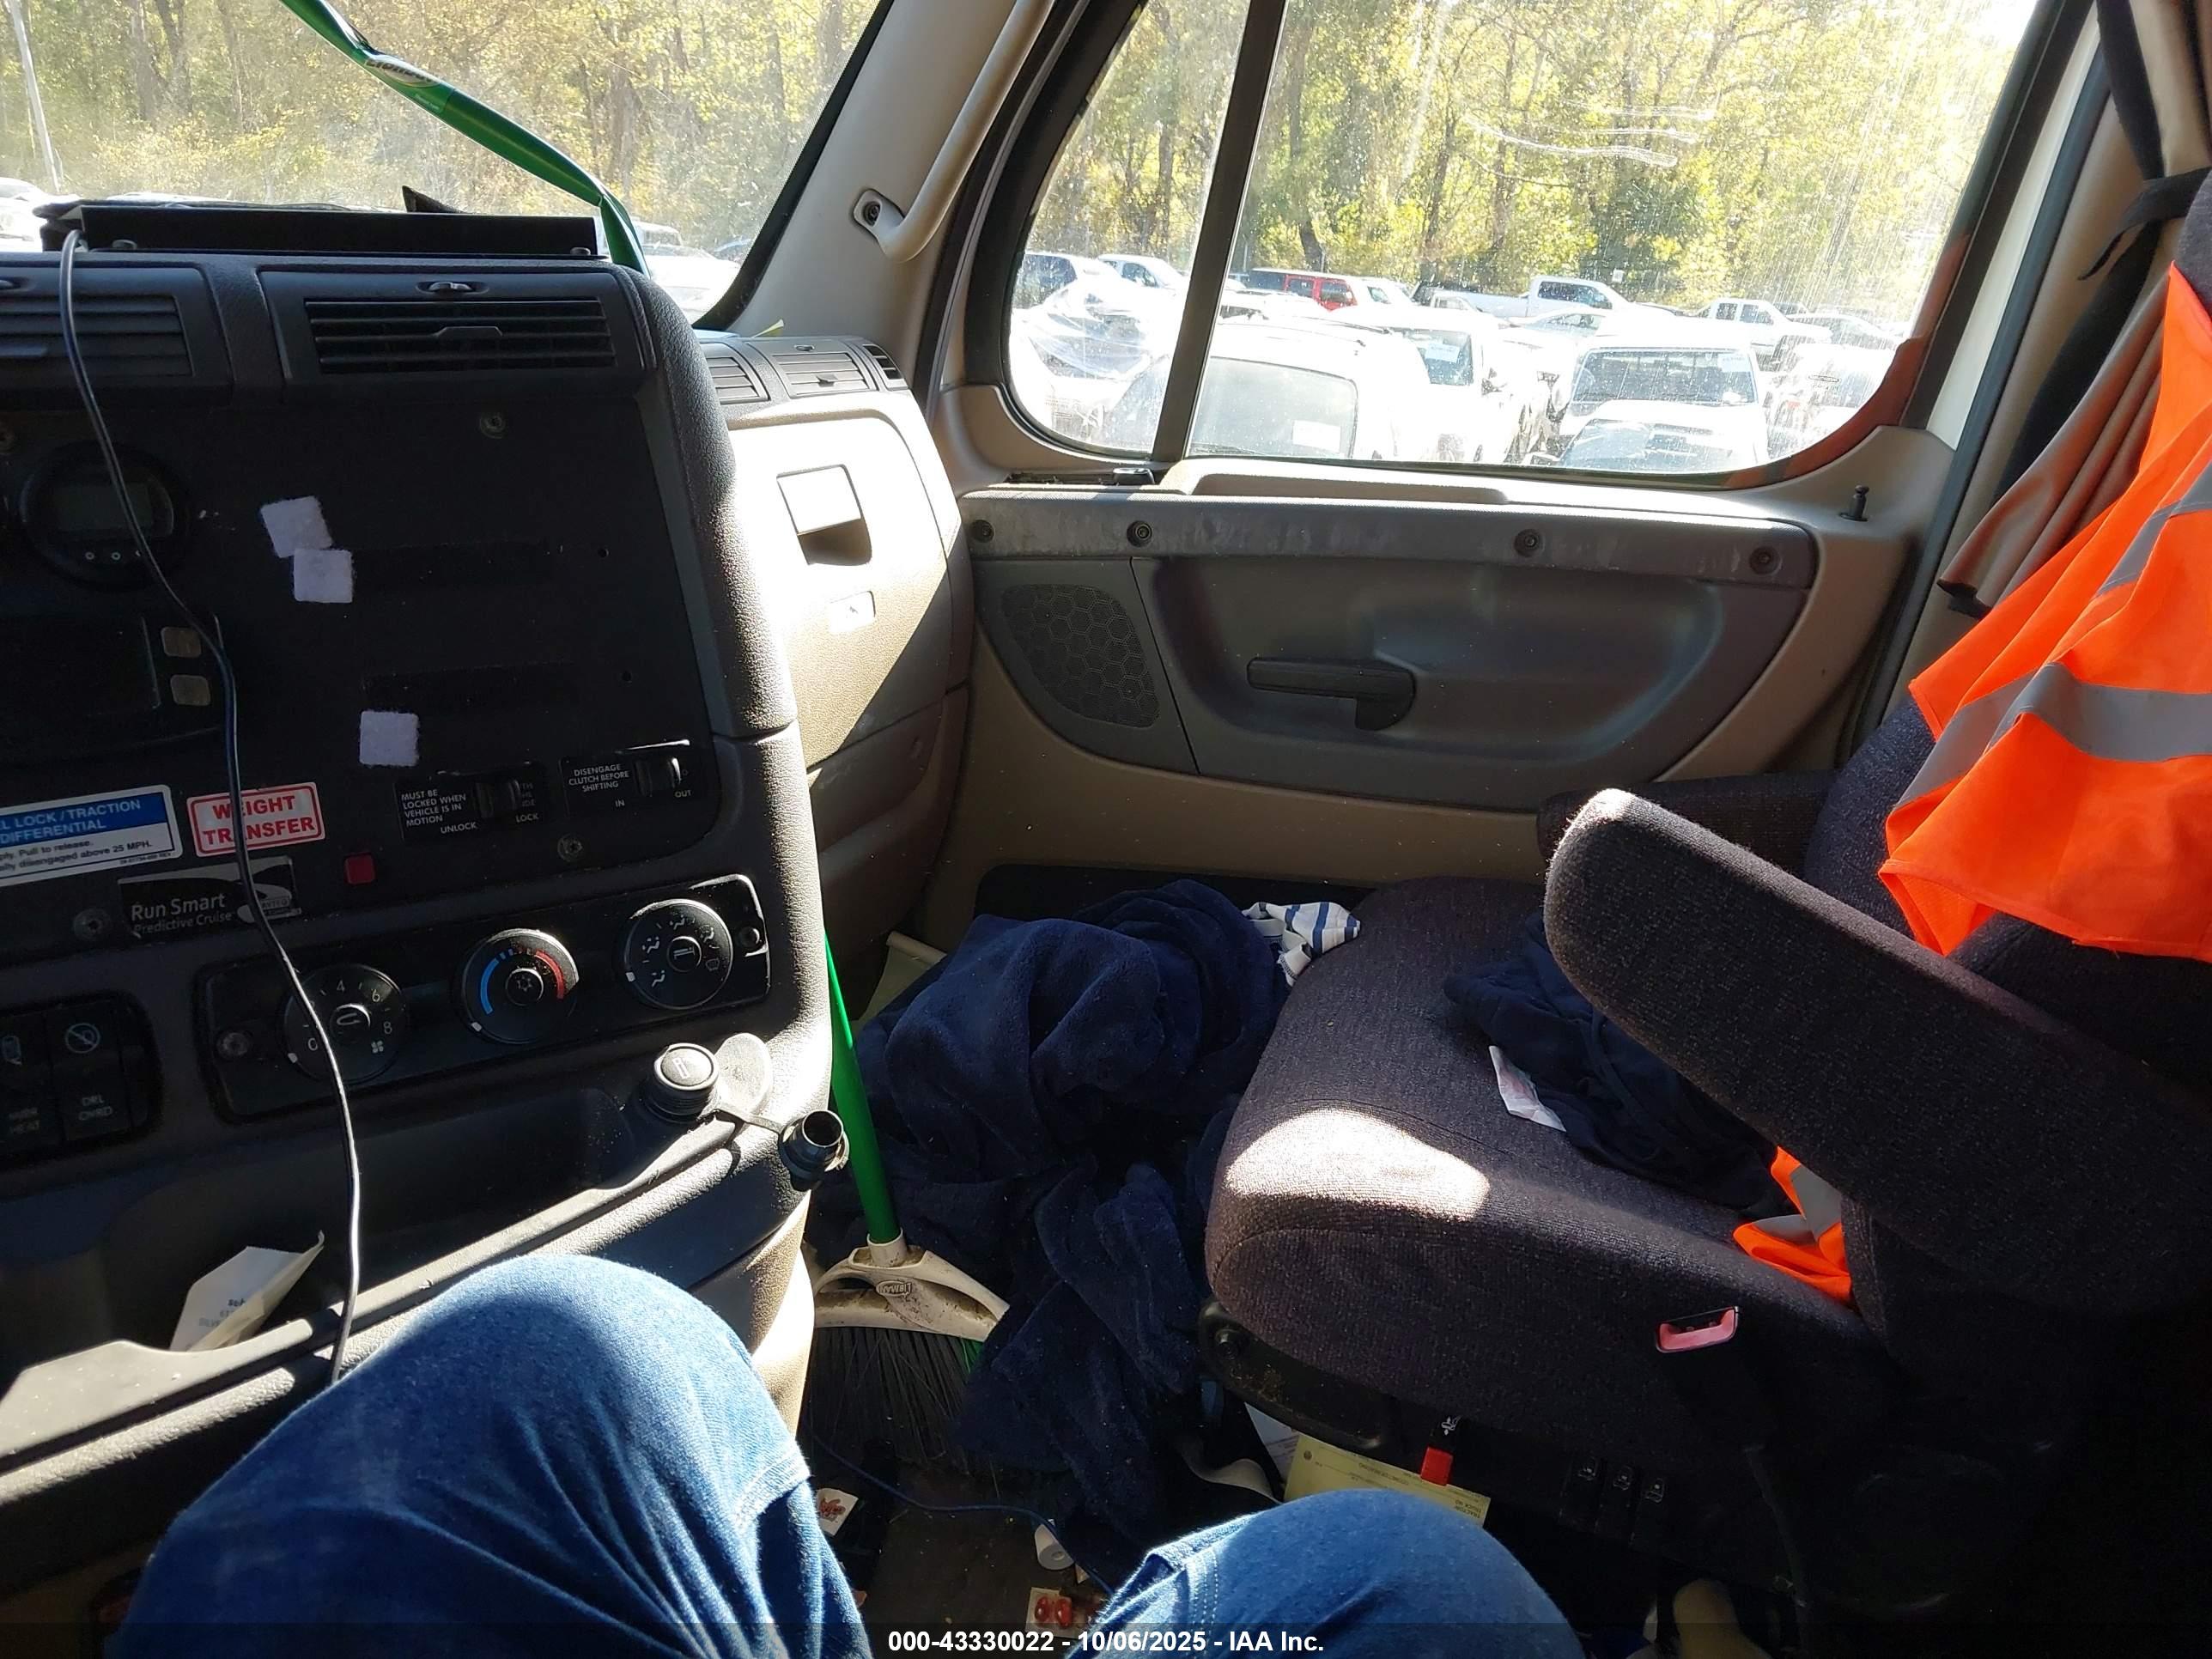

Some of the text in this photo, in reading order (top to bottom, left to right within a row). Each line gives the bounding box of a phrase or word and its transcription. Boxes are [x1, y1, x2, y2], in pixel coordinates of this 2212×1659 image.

[574, 763, 622, 777] DISENGAGE
[568, 770, 630, 787] CLUTCH BEFORE
[401, 789, 439, 800] MUST BE
[582, 781, 619, 793] SHIFTING
[212, 795, 295, 820] WIGHT
[403, 793, 466, 810] LOCKED WHEN
[614, 799, 625, 807] IN
[15, 811, 57, 829] LOCK
[67, 799, 142, 820] TRACTION
[404, 806, 440, 818] VEHICLE
[451, 803, 462, 811] IN
[515, 812, 538, 823] LOCK
[406, 815, 443, 827] MOTION
[440, 821, 477, 834] UNLOCK
[0, 818, 107, 842] DIFFERENTIAL
[203, 817, 315, 846] TRNSFER
[19, 847, 39, 857] Pull
[41, 846, 52, 854] to
[54, 840, 94, 852] release.
[19, 853, 78, 869] disengaged
[81, 848, 111, 860] above
[112, 844, 125, 854] 25
[126, 840, 153, 851] MPH.
[131, 892, 226, 921] Run Smart
[133, 909, 233, 934] Predictive Cruise
[337, 980, 346, 992] 4
[371, 989, 380, 1003] 6
[384, 1022, 392, 1035] 8
